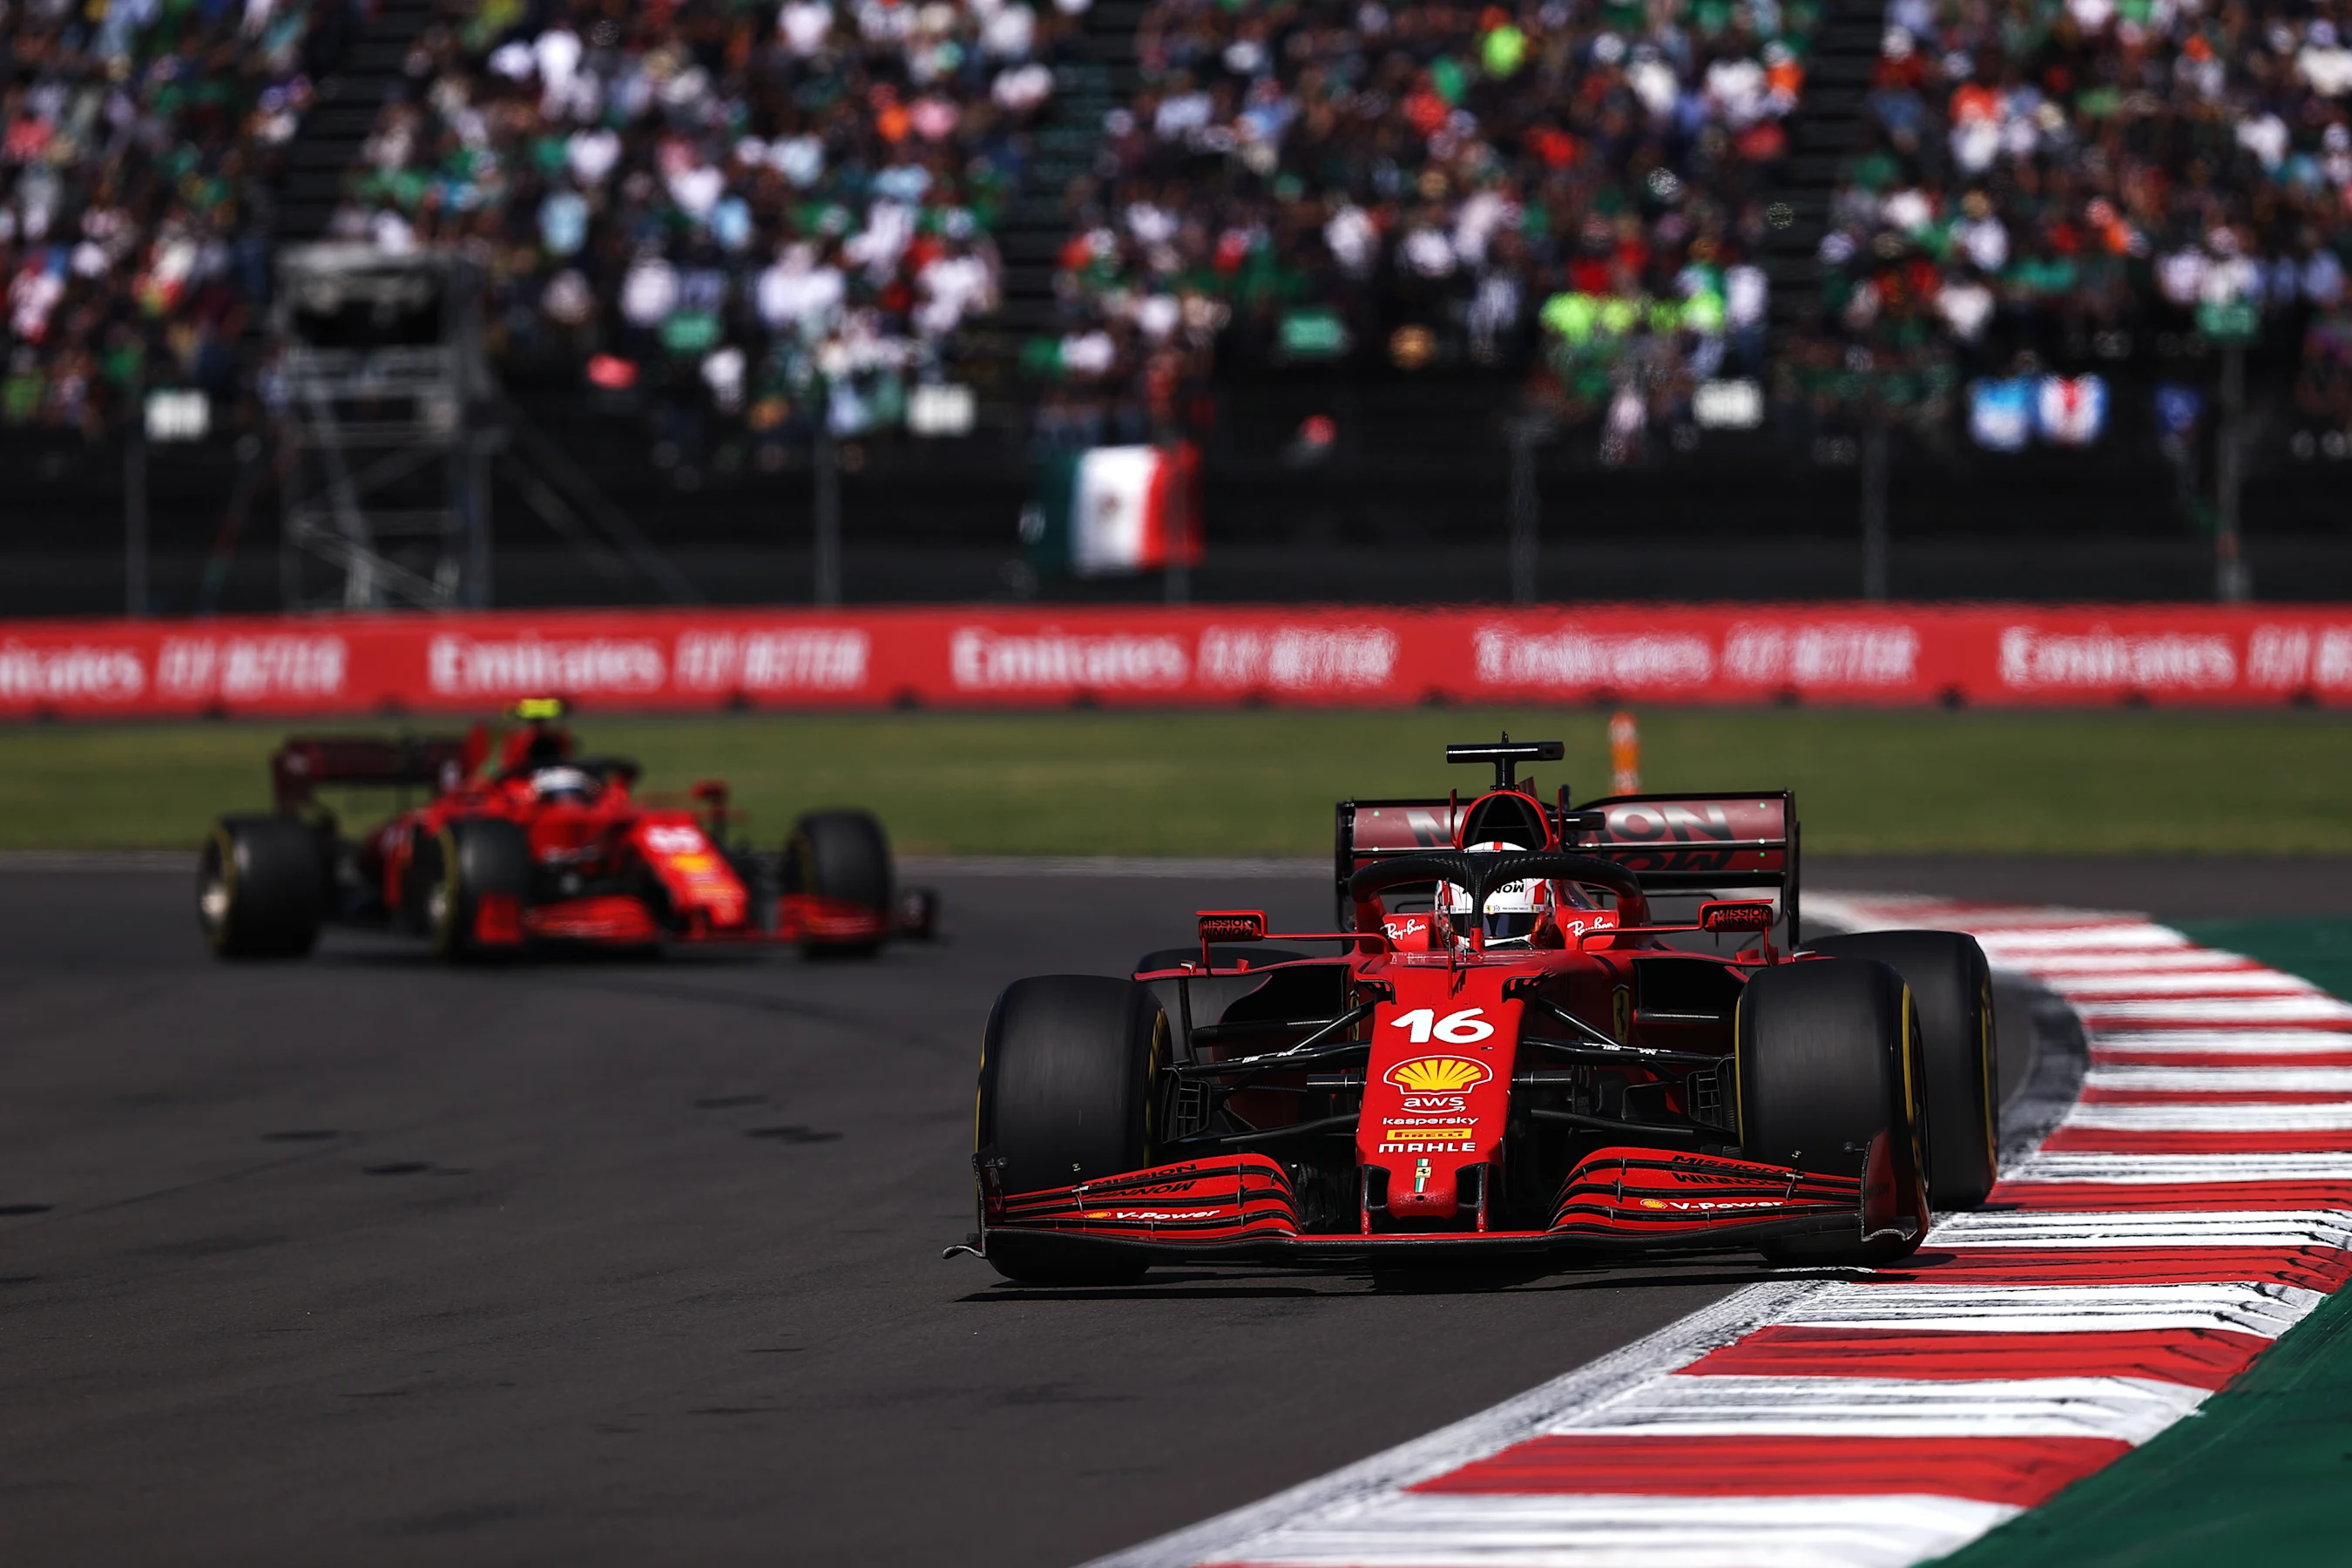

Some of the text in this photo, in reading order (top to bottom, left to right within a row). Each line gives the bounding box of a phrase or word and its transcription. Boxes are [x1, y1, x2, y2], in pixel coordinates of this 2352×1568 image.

[1380, 918, 1427, 940] Ray-Ban
[1390, 1008, 1494, 1044] 16
[1403, 1097, 1464, 1107] aws
[1382, 1117, 1479, 1125] kaspersky
[1378, 1142, 1477, 1153] MAHLE
[1672, 1155, 1789, 1173] MISSION
[1092, 1164, 1197, 1186] MISSION
[1670, 1200, 1783, 1210] V-Power
[1116, 1209, 1220, 1220] V-Power
